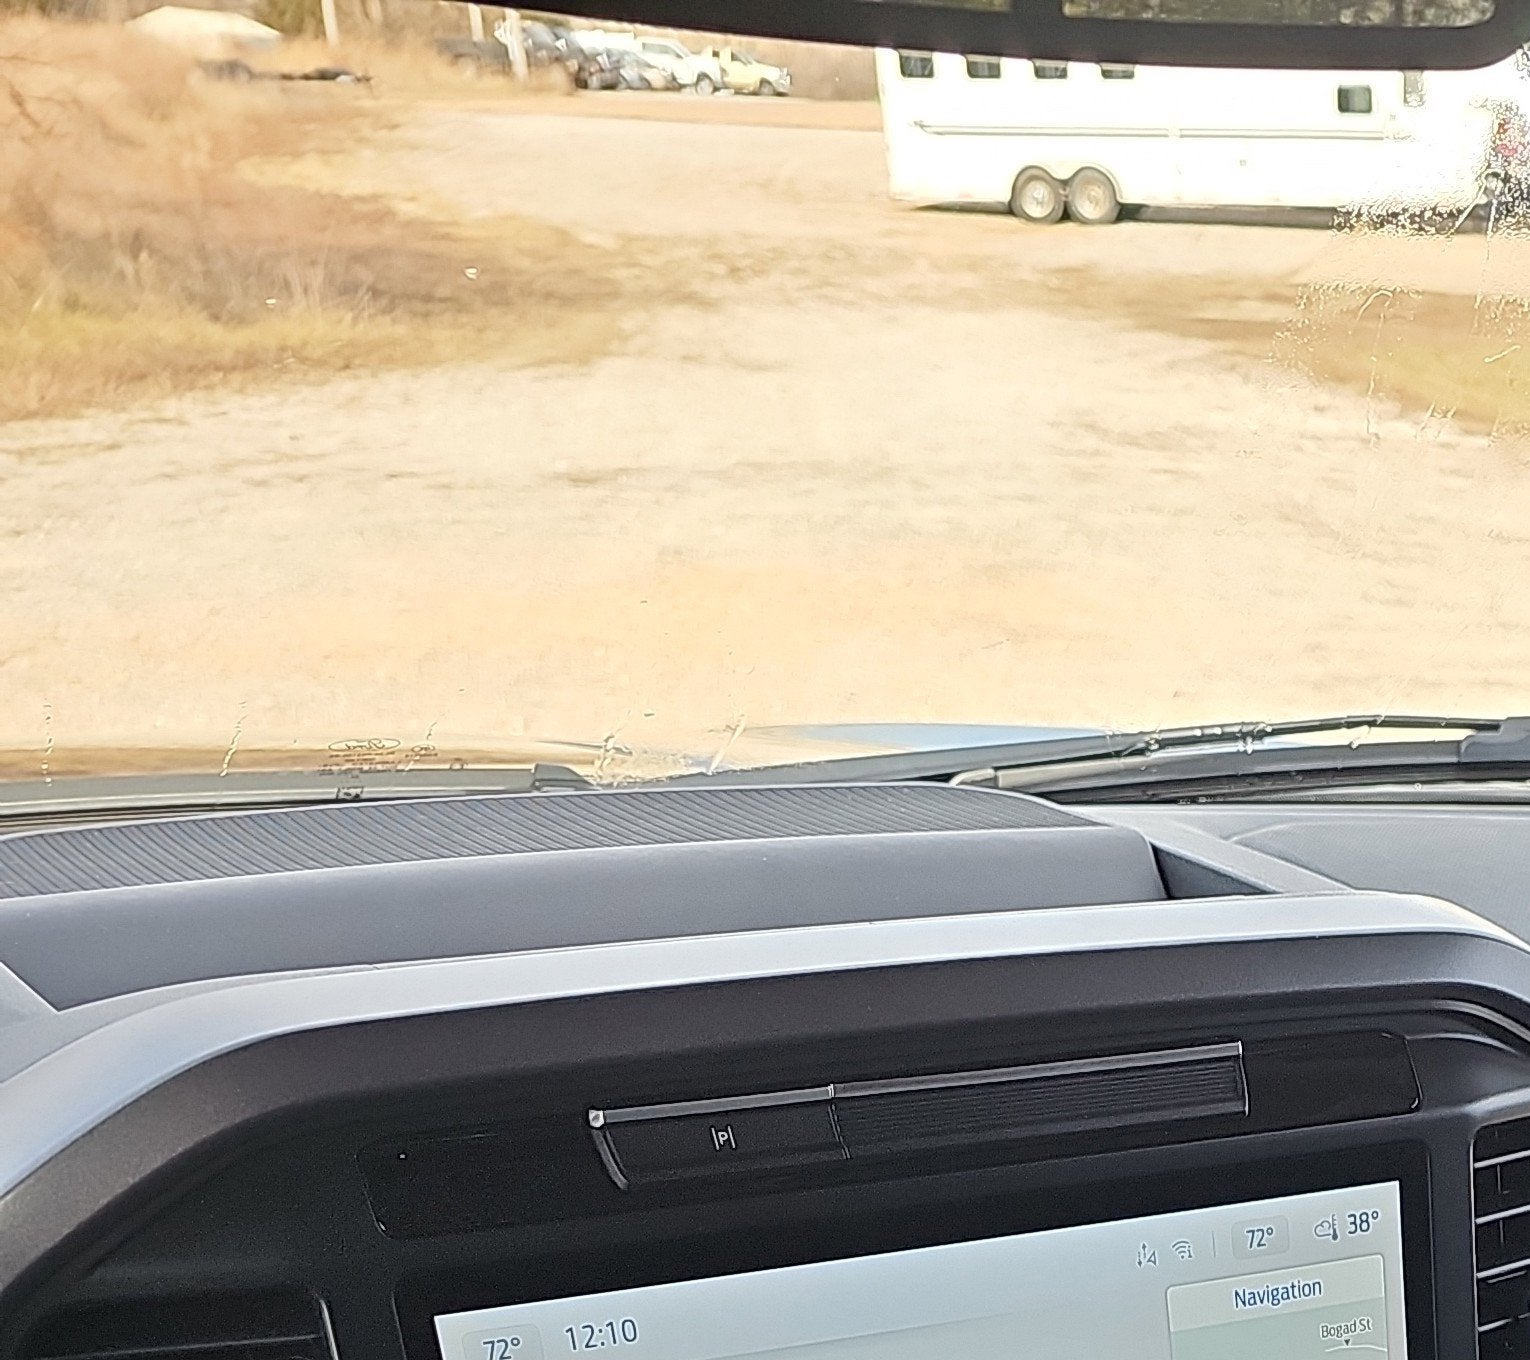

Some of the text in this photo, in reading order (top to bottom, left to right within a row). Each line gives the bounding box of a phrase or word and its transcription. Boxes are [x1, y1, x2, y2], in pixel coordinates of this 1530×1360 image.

[1346, 1210, 1380, 1236] 38°
[1246, 1227, 1274, 1250] 72°
[1234, 1278, 1323, 1310] Navigation
[564, 1318, 639, 1351] 12:10
[1320, 1317, 1372, 1340] Bogad St
